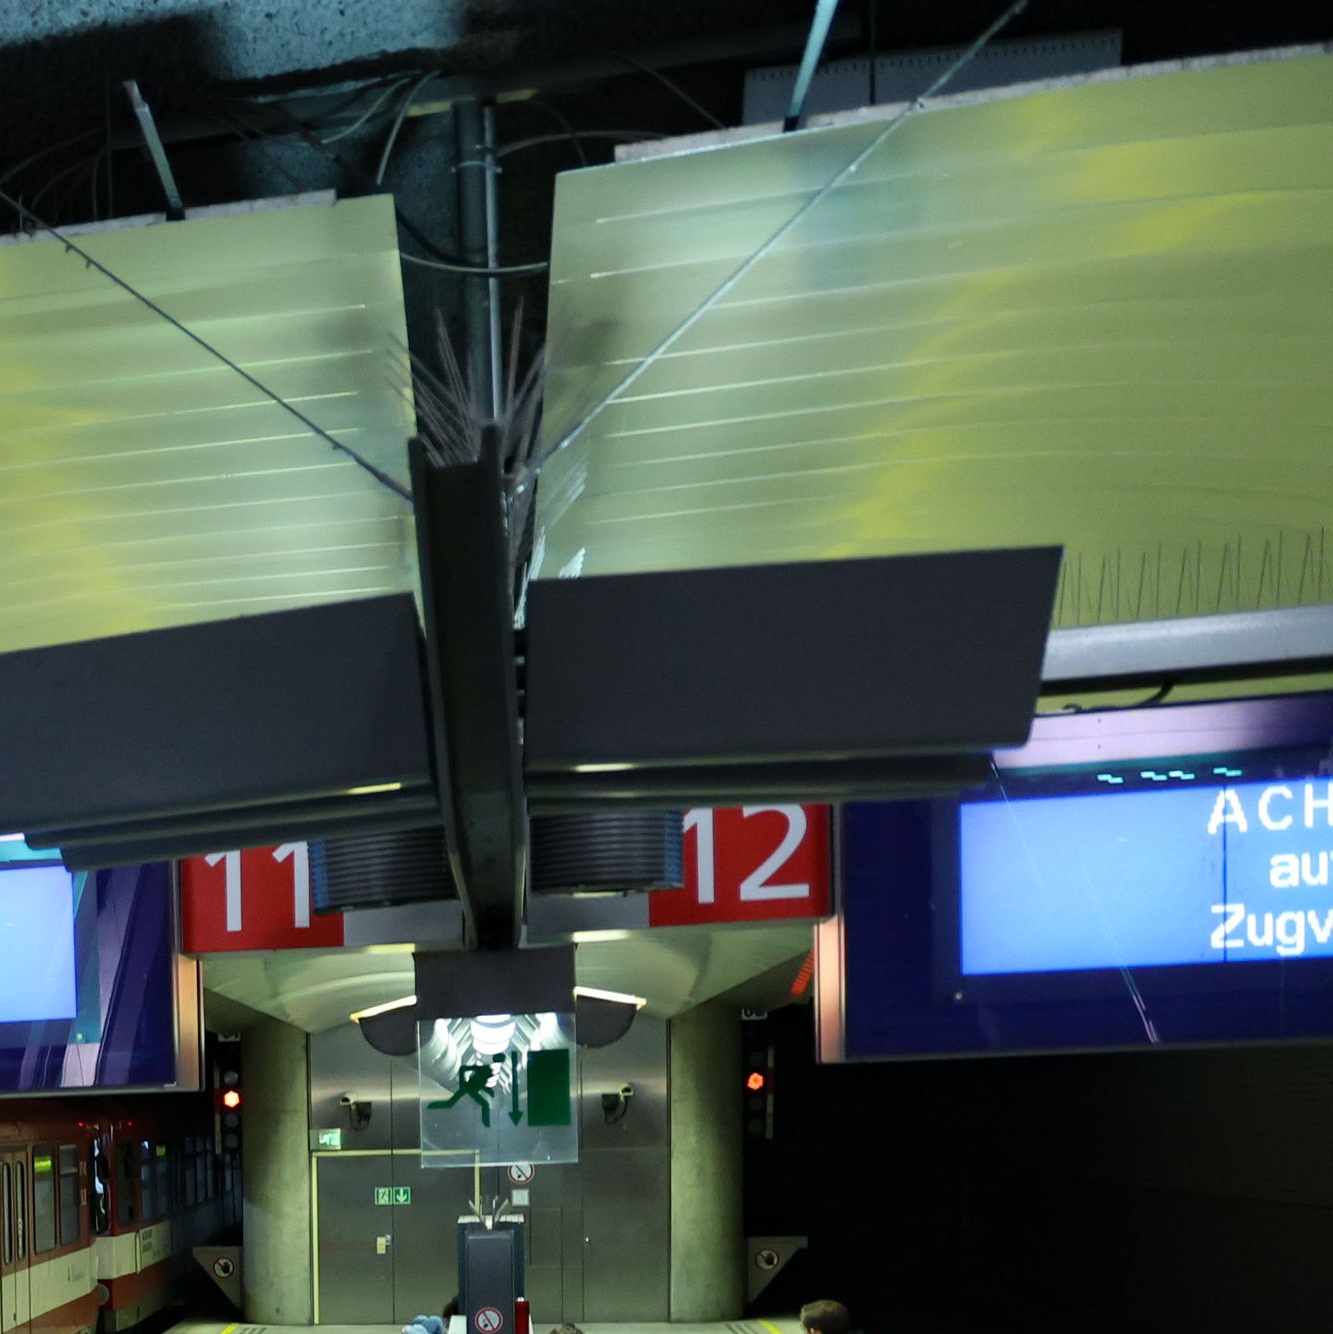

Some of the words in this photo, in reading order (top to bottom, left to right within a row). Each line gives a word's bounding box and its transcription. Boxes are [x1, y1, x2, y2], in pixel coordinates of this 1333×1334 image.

[205, 841, 310, 932] 11
[682, 804, 810, 904] 12
[1270, 850, 1333, 888] au
